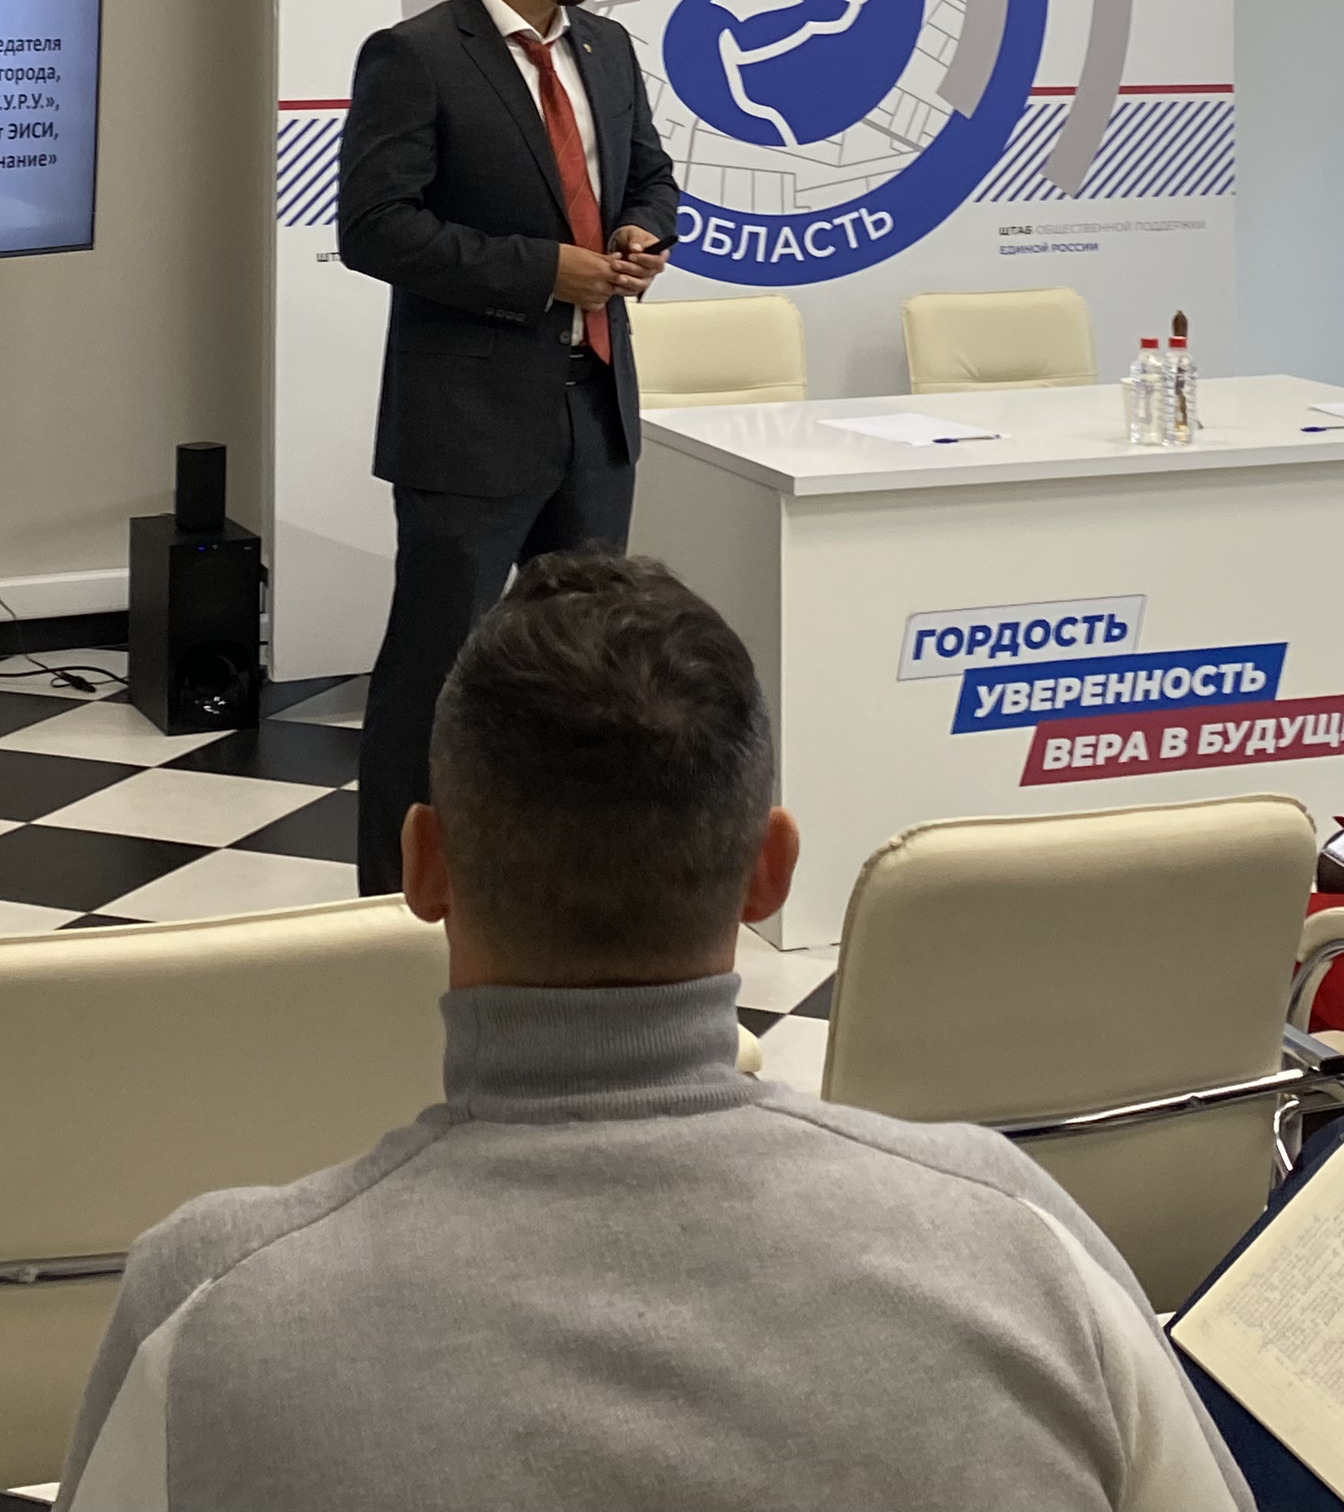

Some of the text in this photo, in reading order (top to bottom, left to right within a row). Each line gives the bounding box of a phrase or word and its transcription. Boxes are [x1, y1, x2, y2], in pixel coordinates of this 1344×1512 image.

[8, 122, 59, 141] ЭИСИ,
[676, 205, 894, 263] ОБЛАСТЬ
[999, 225, 1033, 236] ШТАБ
[1000, 242, 1099, 255] ЕДИНОЙ РОССИИ
[912, 613, 1129, 661] ГОРДОСТЬ
[973, 662, 1267, 719] УВЕРЕННОСТЬ
[1042, 730, 1149, 771] ВЕРА
[1160, 727, 1188, 759] В
